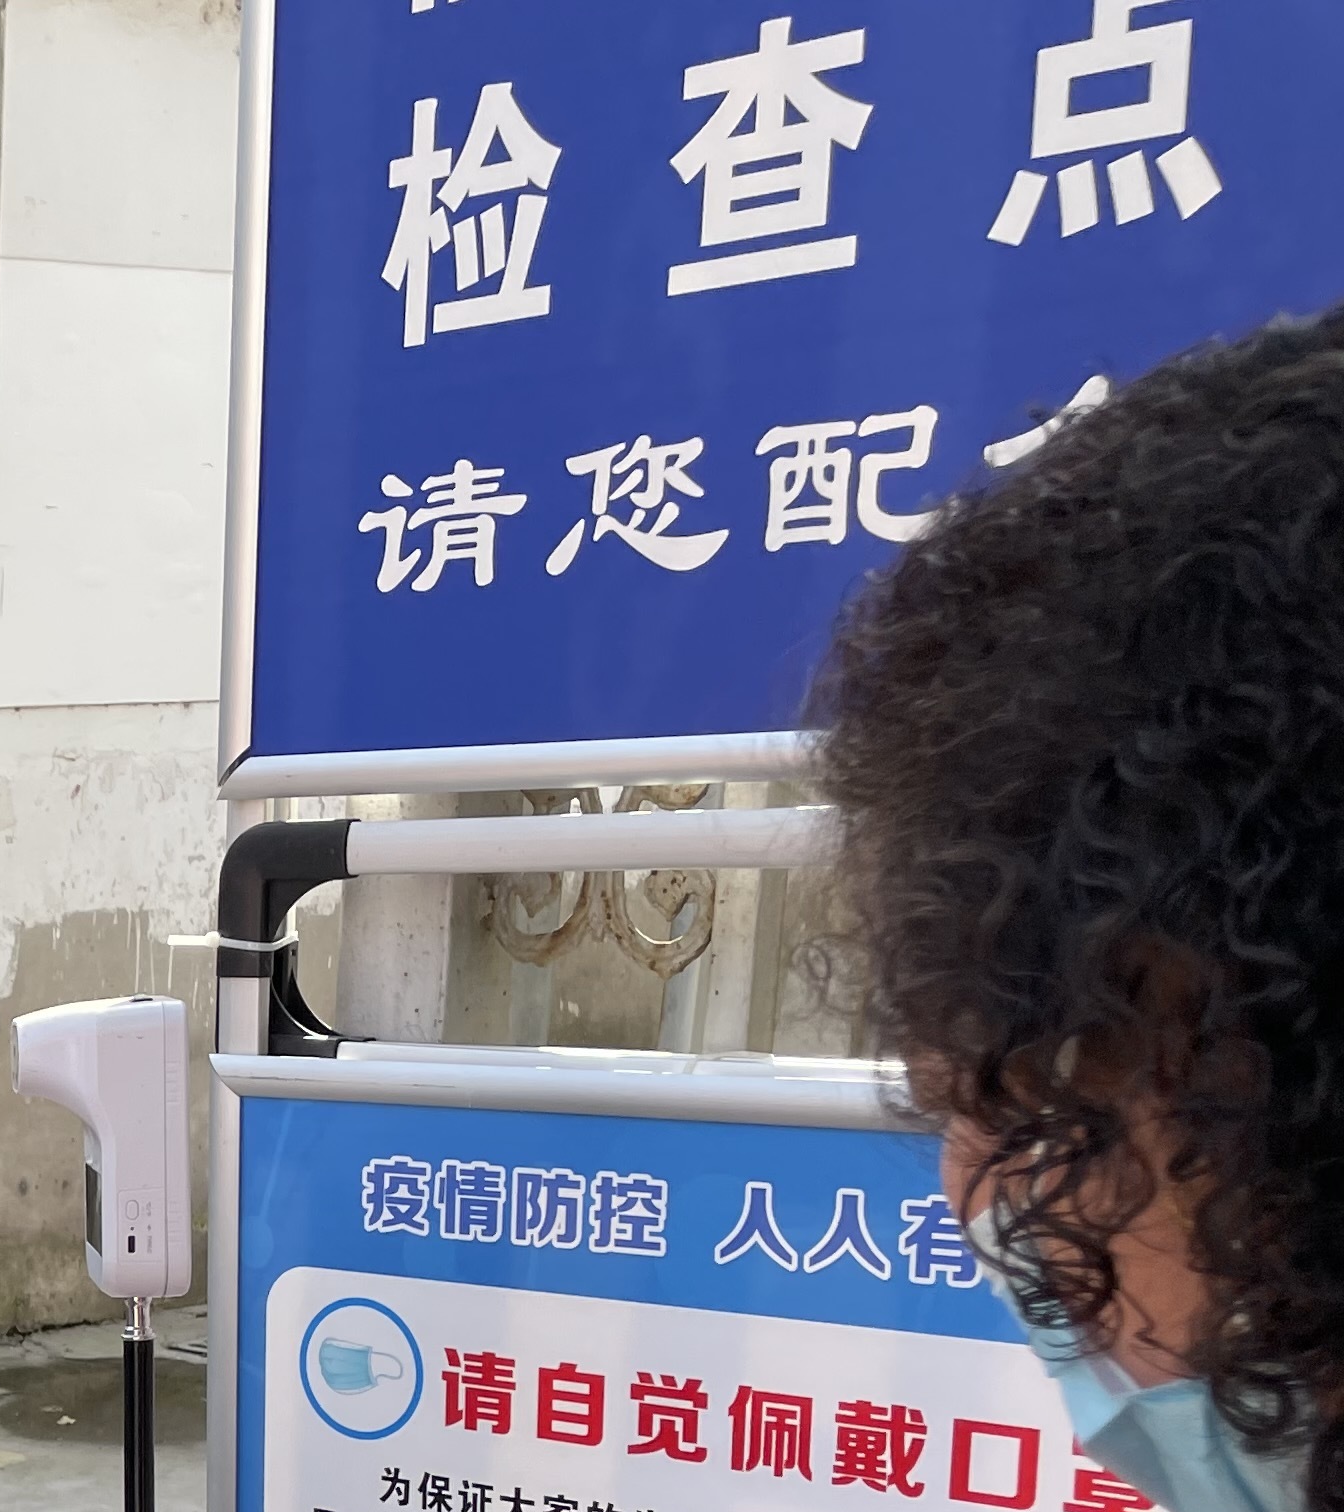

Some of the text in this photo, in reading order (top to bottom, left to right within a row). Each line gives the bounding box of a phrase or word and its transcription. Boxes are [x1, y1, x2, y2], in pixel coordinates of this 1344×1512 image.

[381, 0, 1221, 347] 检查点
[362, 1155, 667, 1258] 疫情防控
